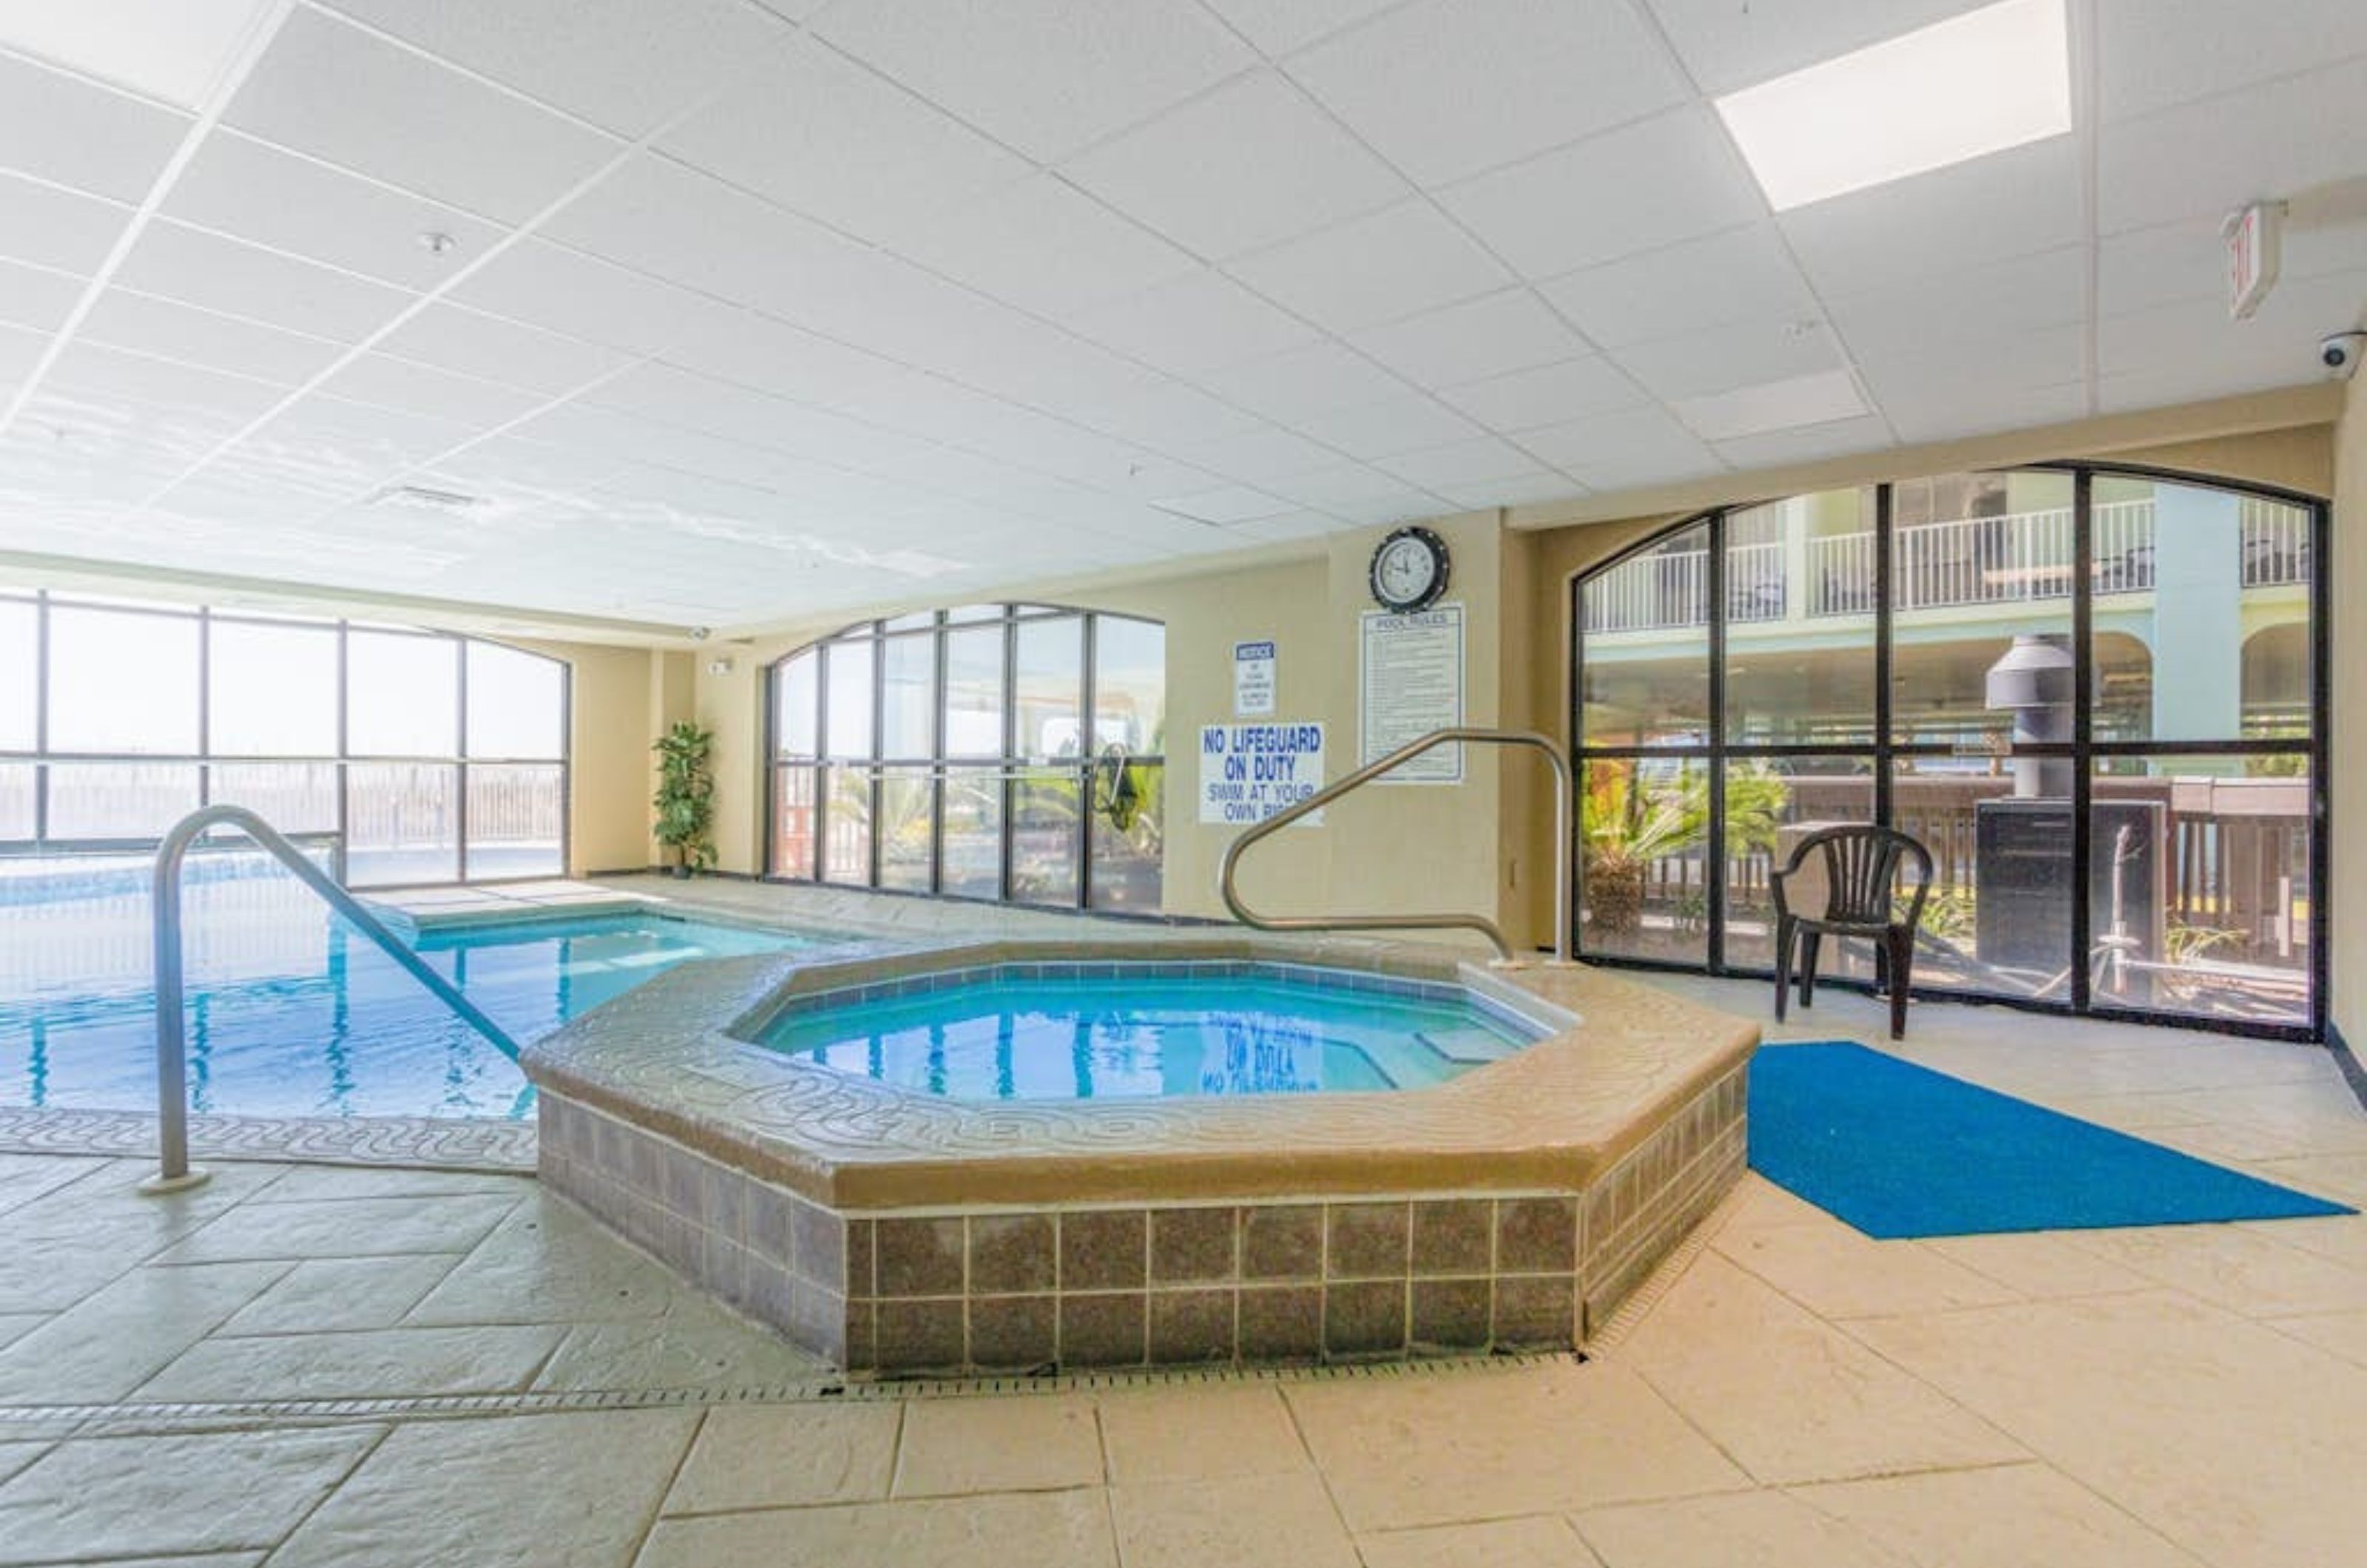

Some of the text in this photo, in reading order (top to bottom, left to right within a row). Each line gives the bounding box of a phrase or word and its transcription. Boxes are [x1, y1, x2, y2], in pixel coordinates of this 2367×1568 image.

[1376, 617, 1405, 629] POOL
[1203, 726, 1321, 754] NO LIFEGUARD
[1224, 754, 1296, 781] ON DUTY
[1207, 783, 1314, 802] SWIM AT YOUR
[1224, 803, 1257, 820] OWN
